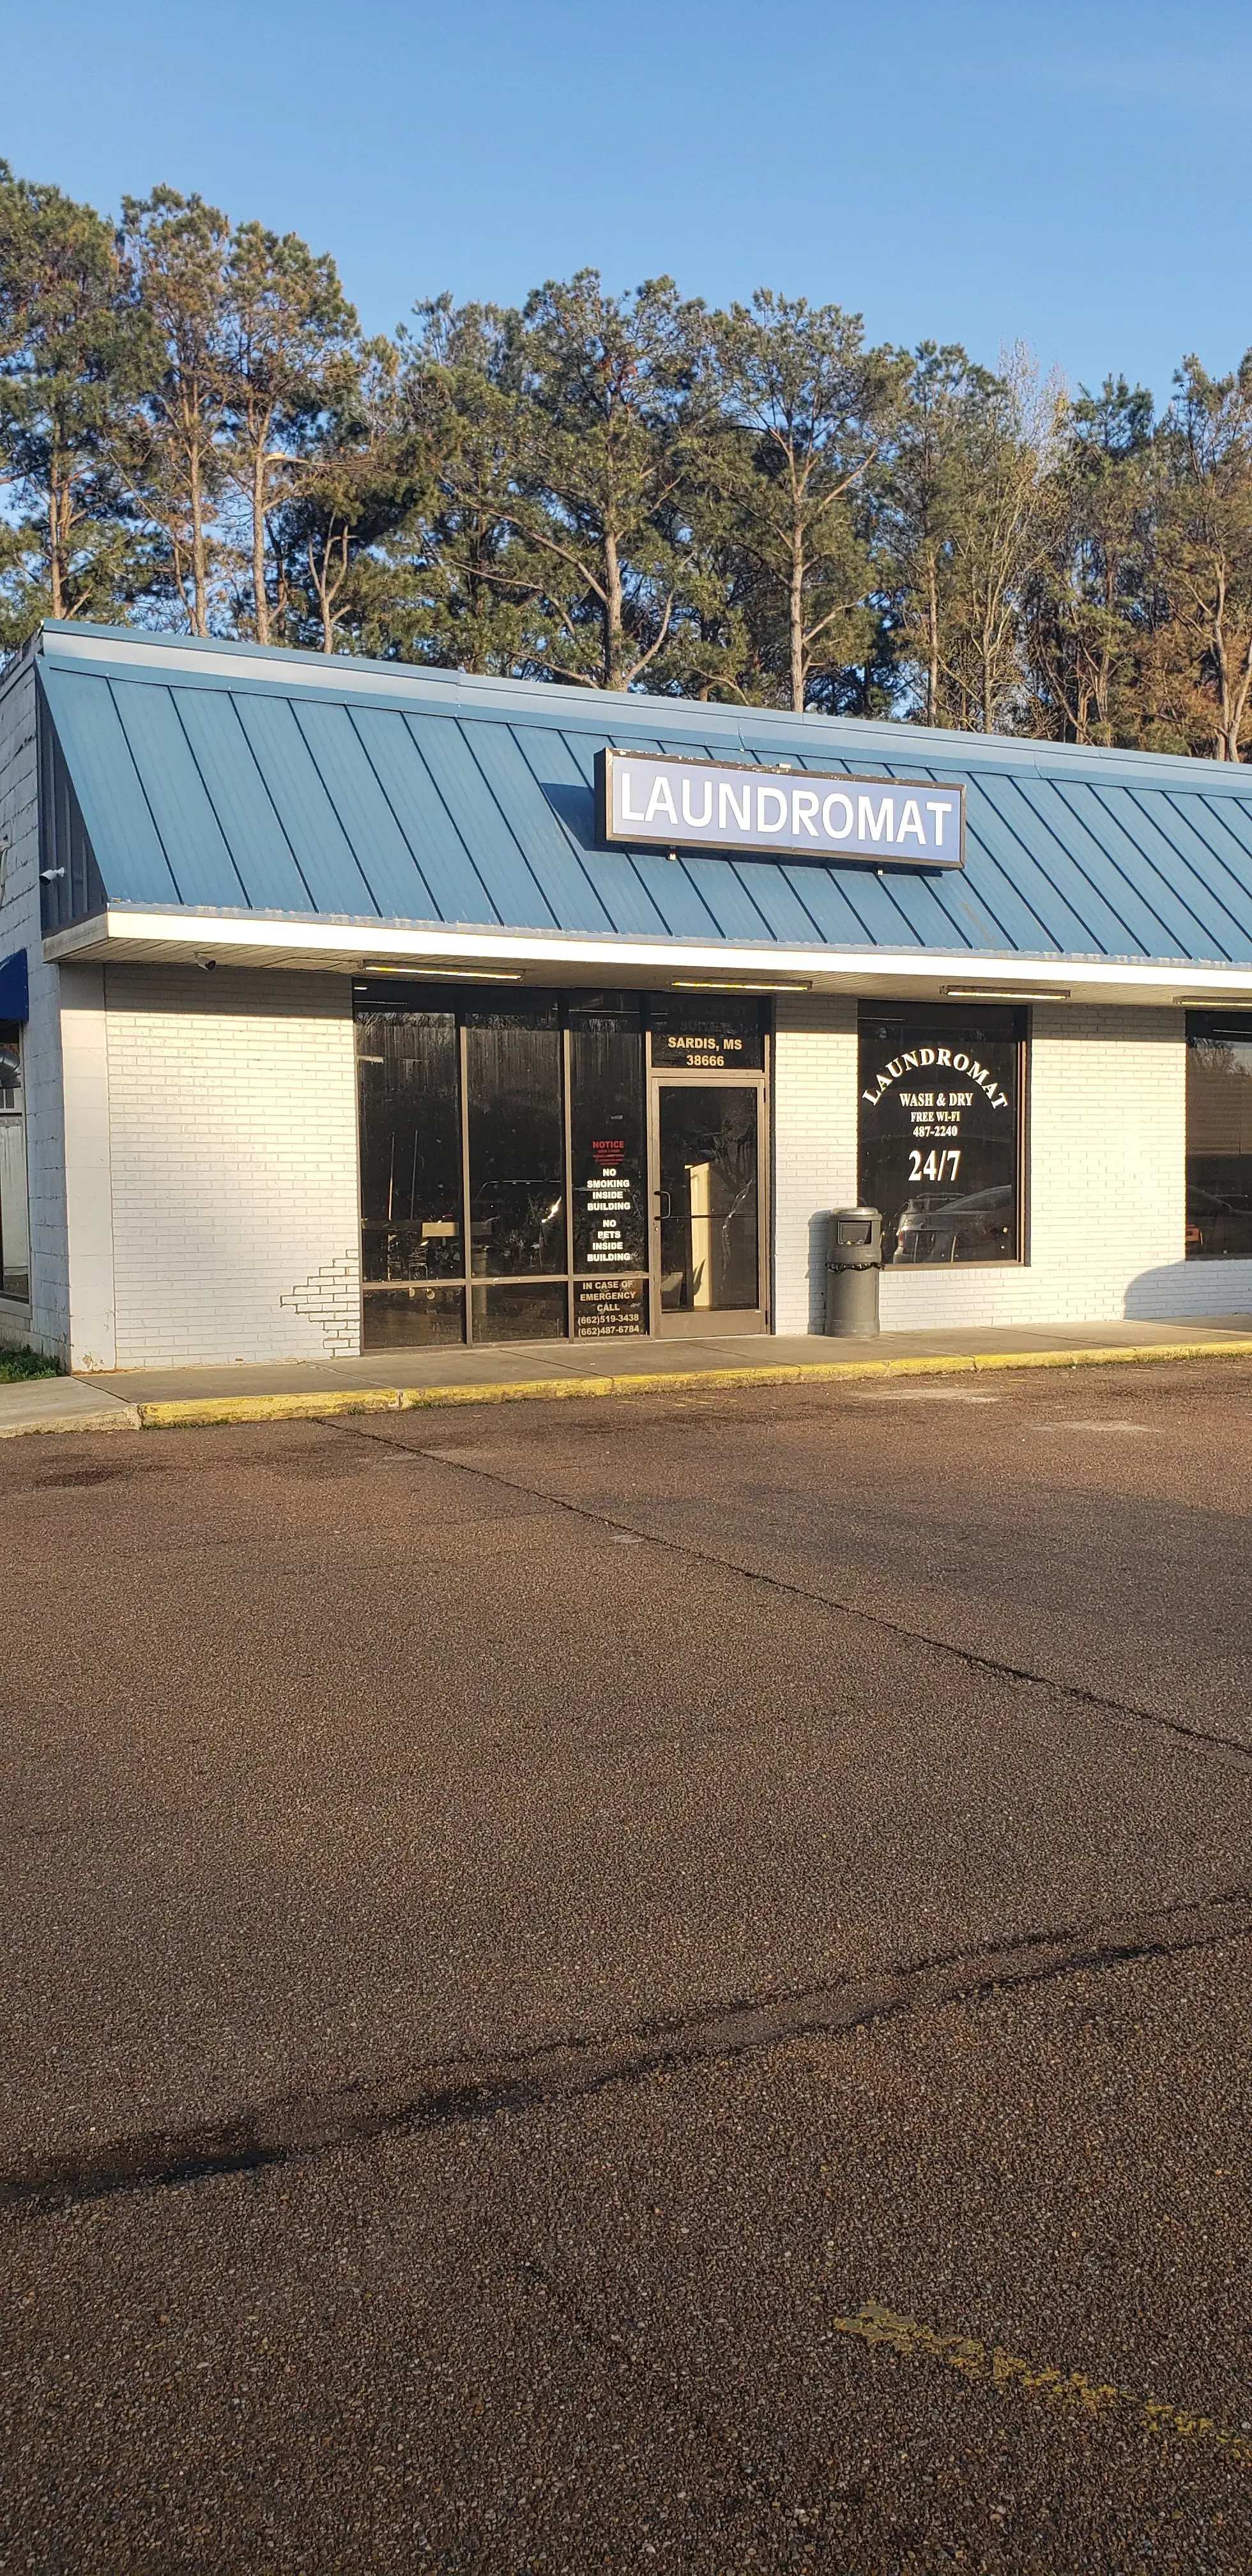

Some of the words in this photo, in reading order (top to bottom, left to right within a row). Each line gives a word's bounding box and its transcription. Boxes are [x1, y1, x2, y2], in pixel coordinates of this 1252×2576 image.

[622, 772, 952, 846] LAUNDROMAT
[668, 1037, 719, 1051] SARDIS,
[724, 1039, 742, 1050] MS
[687, 1055, 724, 1066] 38666
[862, 1048, 1008, 1108] LAUNDROMAT
[899, 1093, 934, 1107] WASH
[936, 1093, 946, 1106] &
[949, 1093, 973, 1106] DRY
[911, 1112, 935, 1122] FREE
[936, 1111, 960, 1121] WI-FI
[913, 1126, 958, 1137] 487-2240
[908, 1150, 961, 1181] 24/7
[587, 1179, 630, 1188] SMOKING
[593, 1191, 623, 1199] INSIDE
[588, 1202, 630, 1211] BUILDING
[593, 1241, 623, 1250] INSIDE
[587, 1253, 630, 1261] BUILDING
[581, 1291, 636, 1301] EMERGENCY
[578, 1314, 639, 1326] (662)519-3438
[578, 1325, 639, 1337] (662)487-6784
